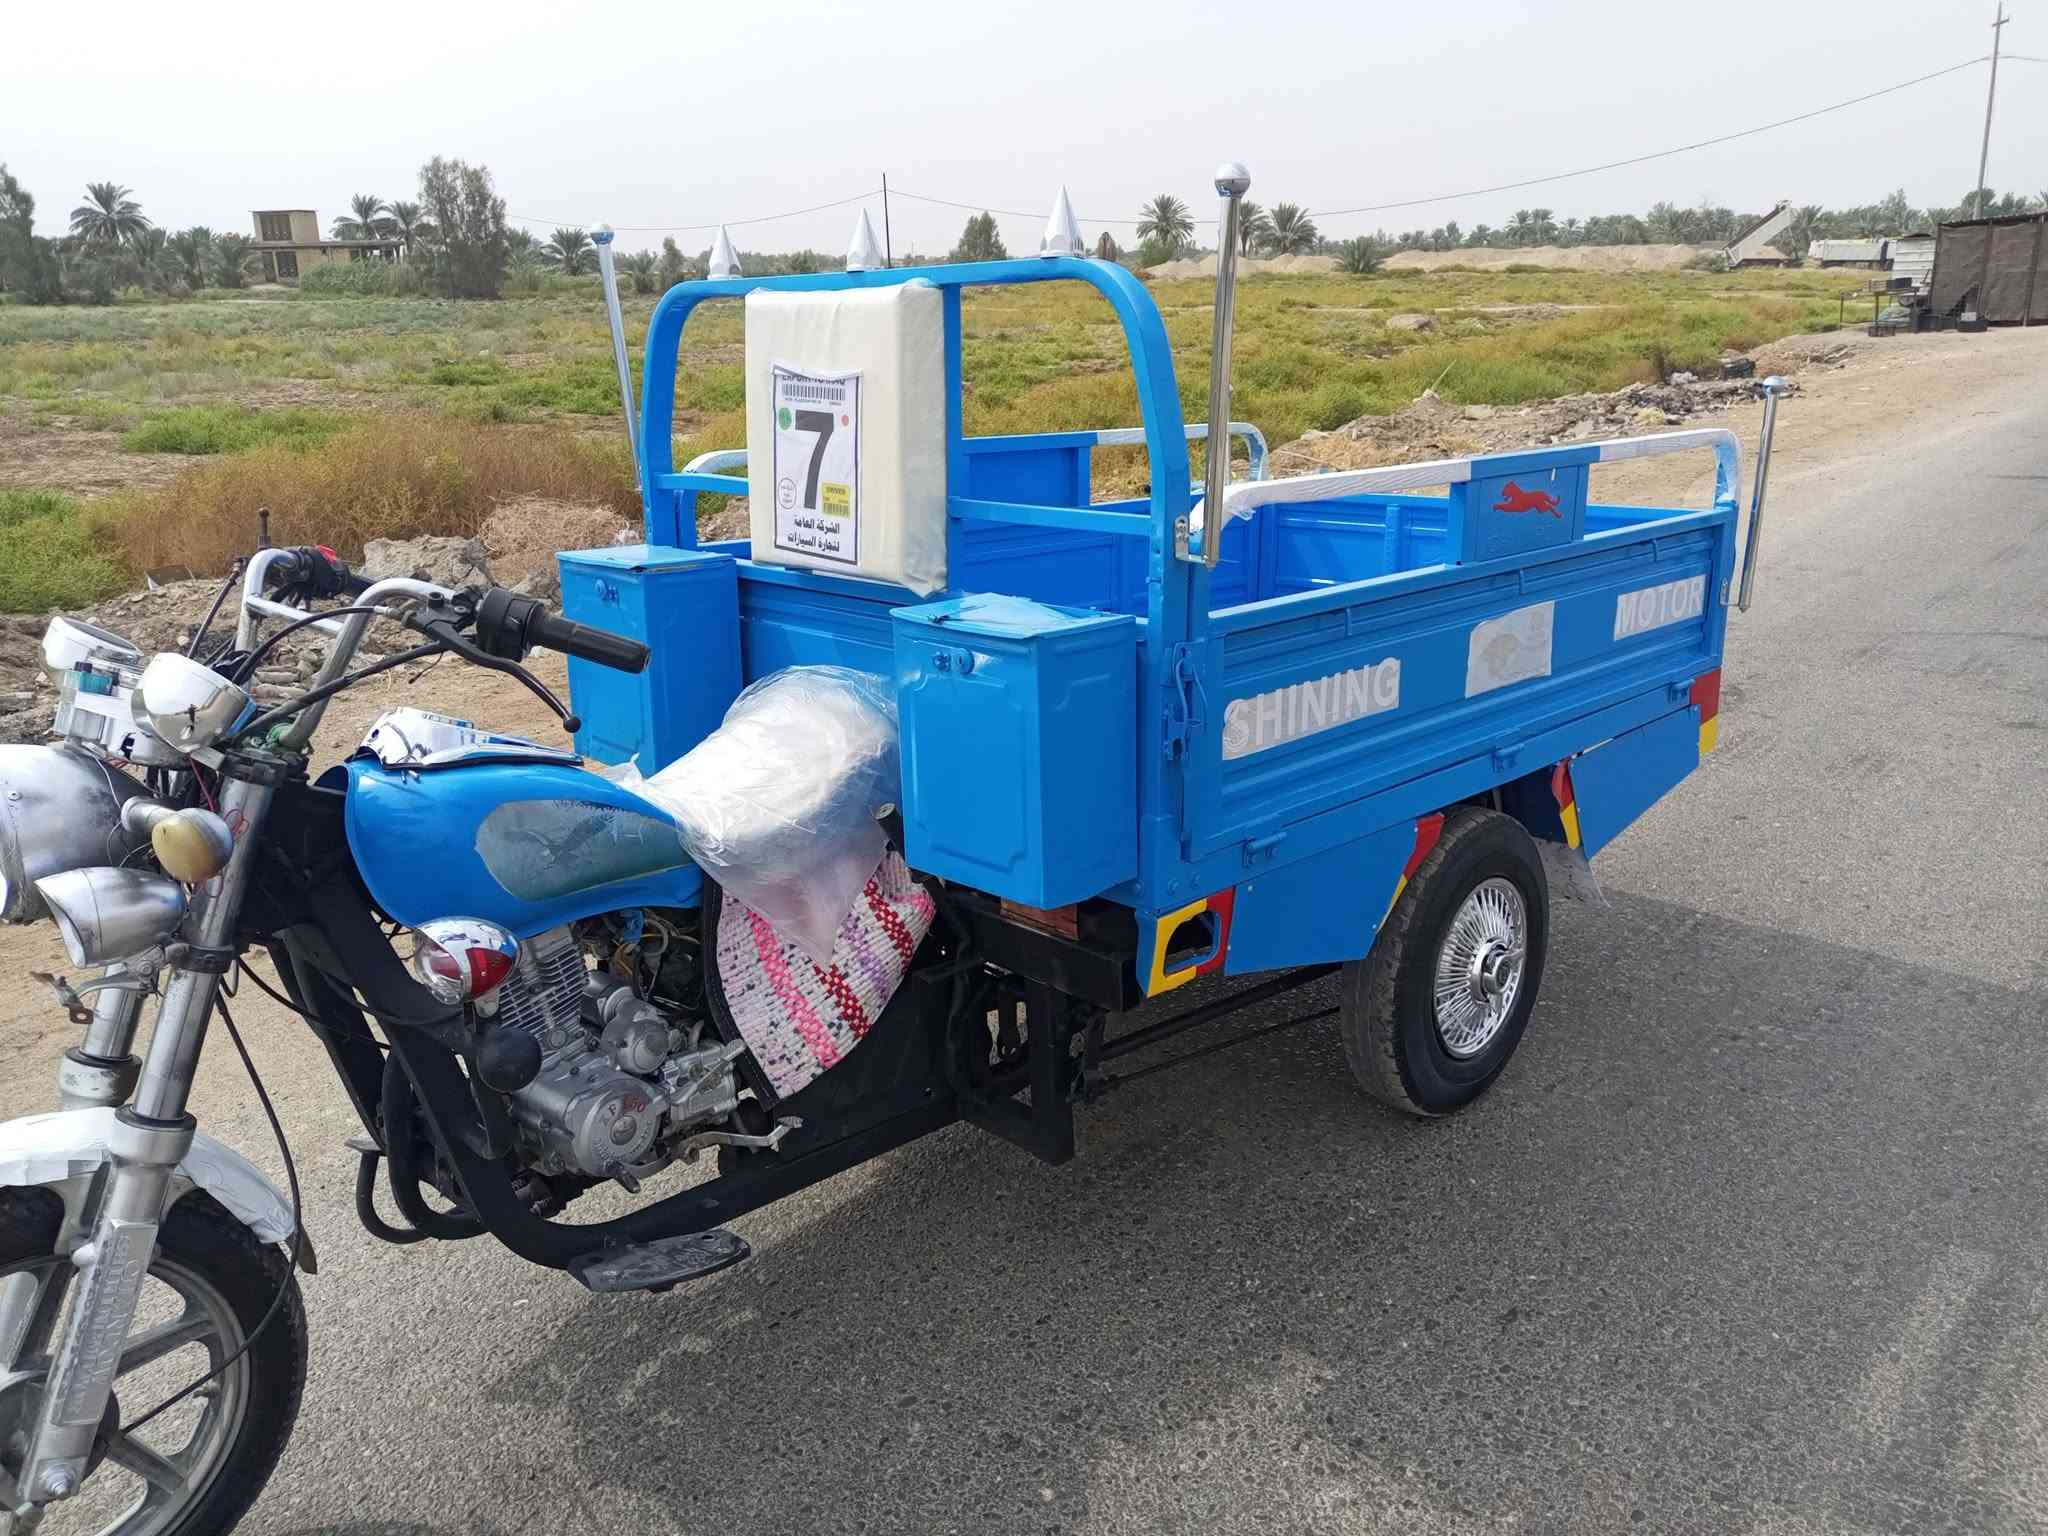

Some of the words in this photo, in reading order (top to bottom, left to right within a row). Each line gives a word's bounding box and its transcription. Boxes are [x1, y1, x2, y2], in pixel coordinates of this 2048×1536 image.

[795, 409, 834, 509] 7
[1223, 656, 1400, 754] SHINING
[1616, 575, 1704, 638] MOTOR
